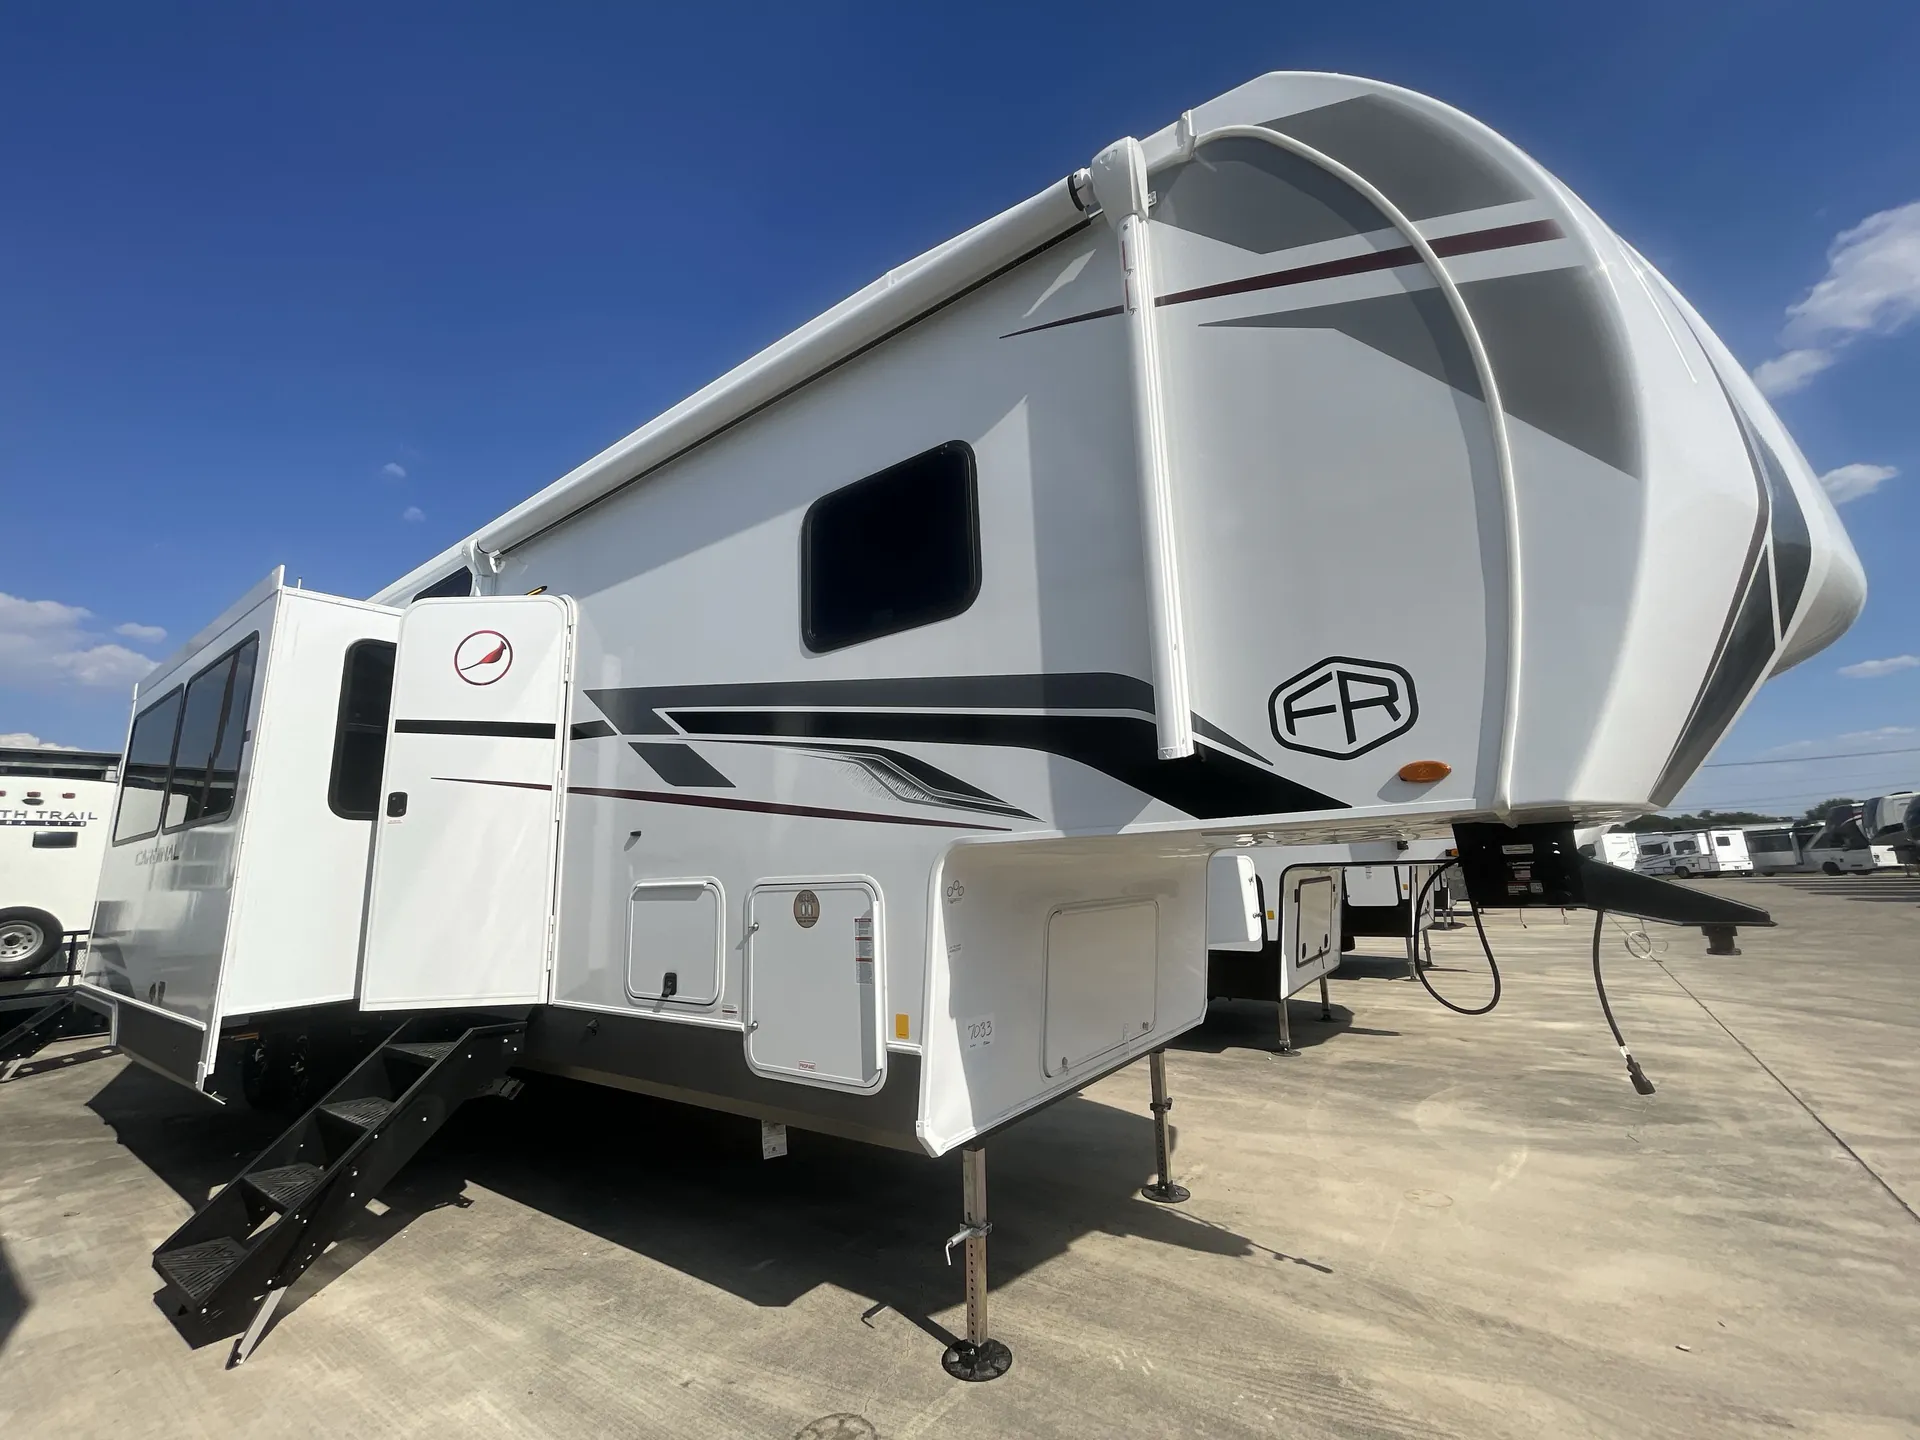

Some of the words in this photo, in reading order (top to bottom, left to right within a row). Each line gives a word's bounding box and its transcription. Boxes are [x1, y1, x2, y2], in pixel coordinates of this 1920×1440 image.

[1283, 670, 1401, 745] FR
[36, 811, 98, 820] TRAIL
[968, 1021, 993, 1040] 7033
